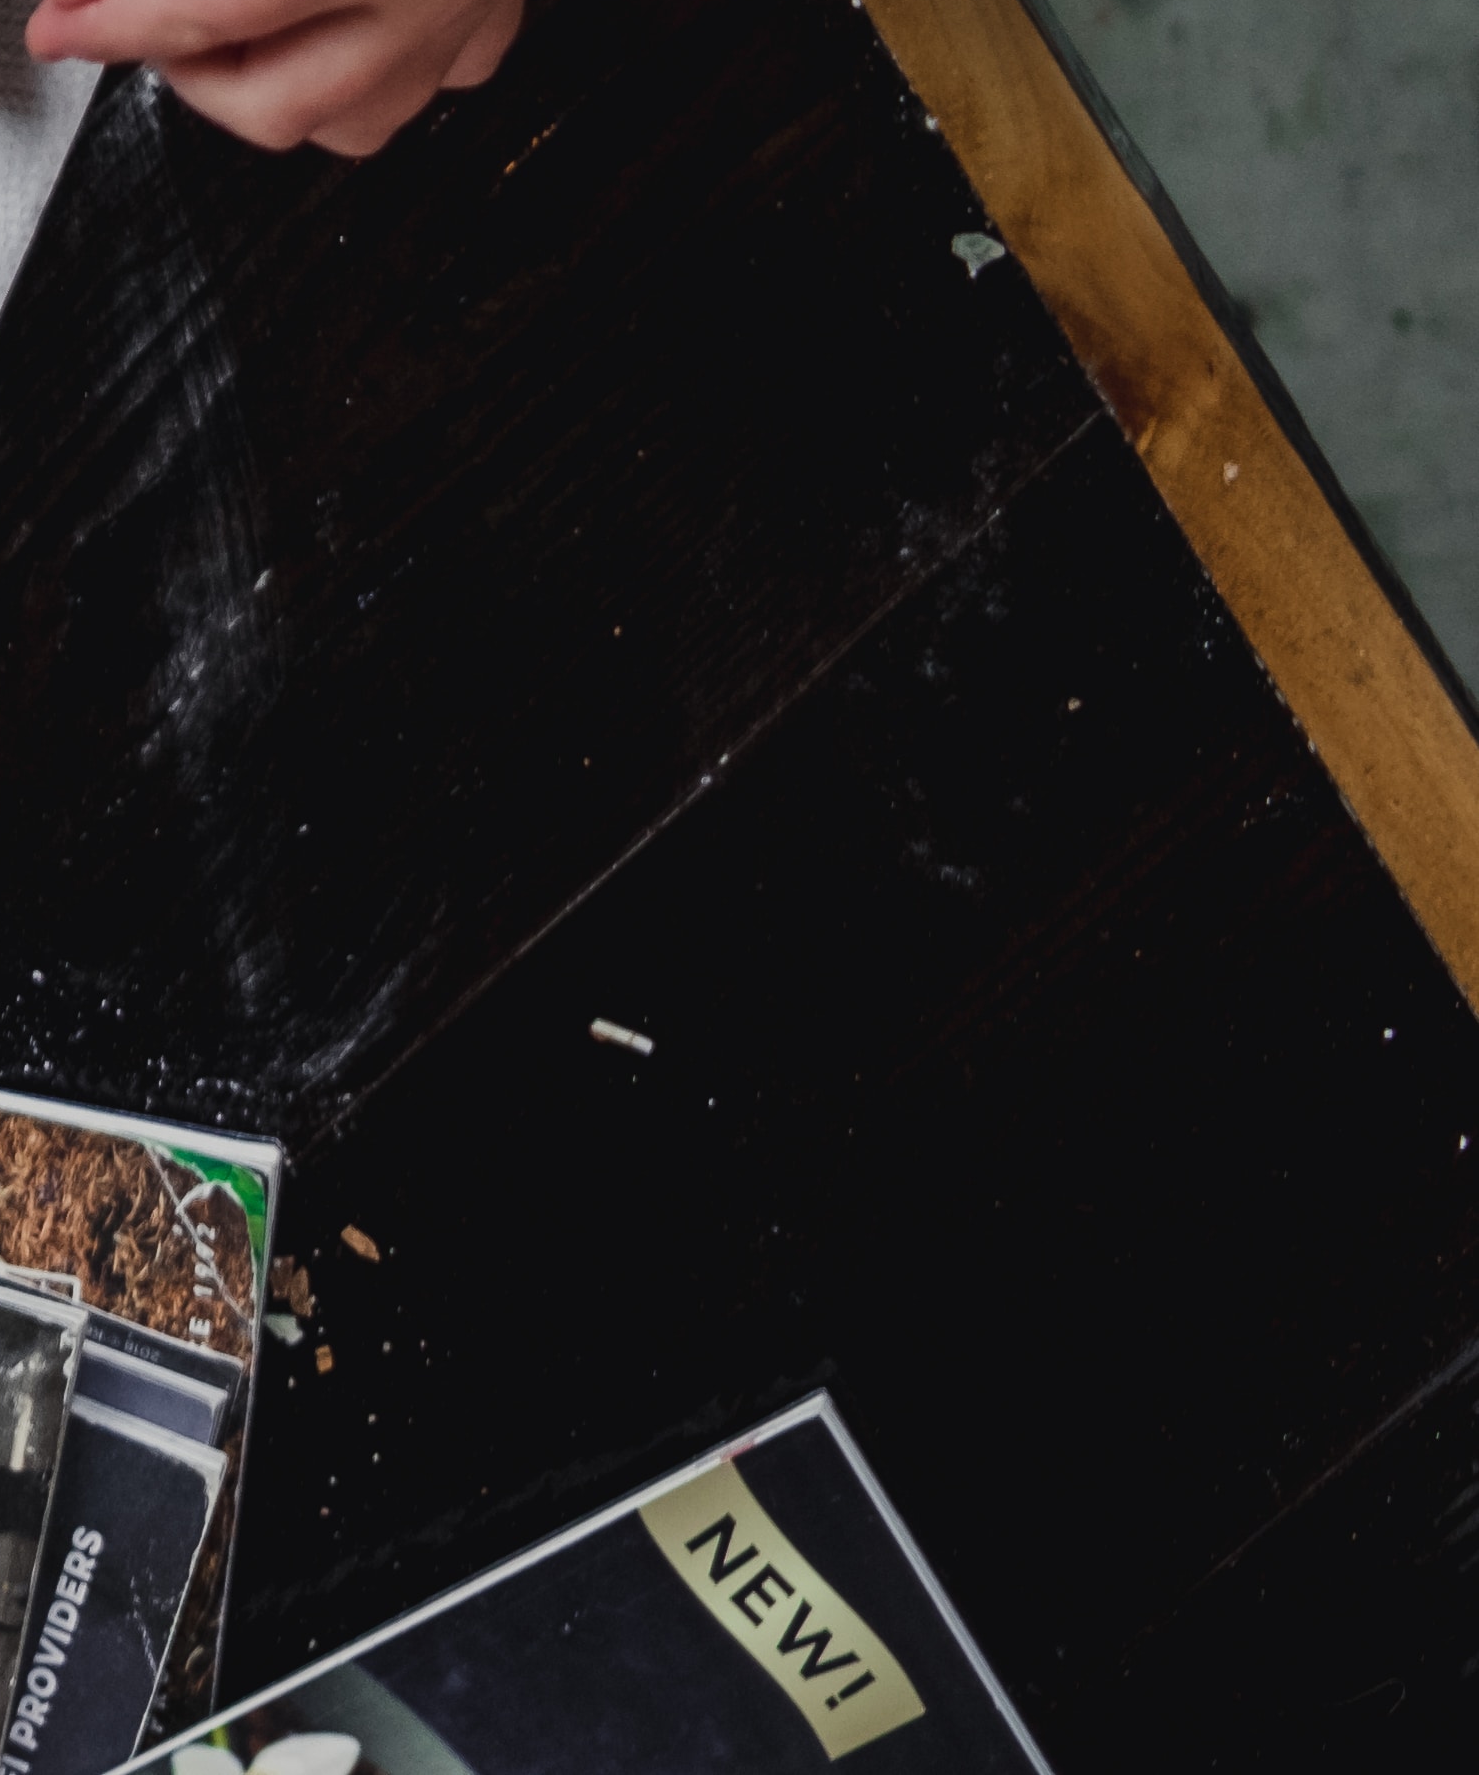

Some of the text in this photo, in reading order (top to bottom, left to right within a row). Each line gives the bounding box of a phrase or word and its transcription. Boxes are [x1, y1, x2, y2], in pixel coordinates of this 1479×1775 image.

[189, 1316, 211, 1337] E
[9, 1525, 104, 1751] PROVIDERS
[683, 1511, 877, 1712] NEW!
